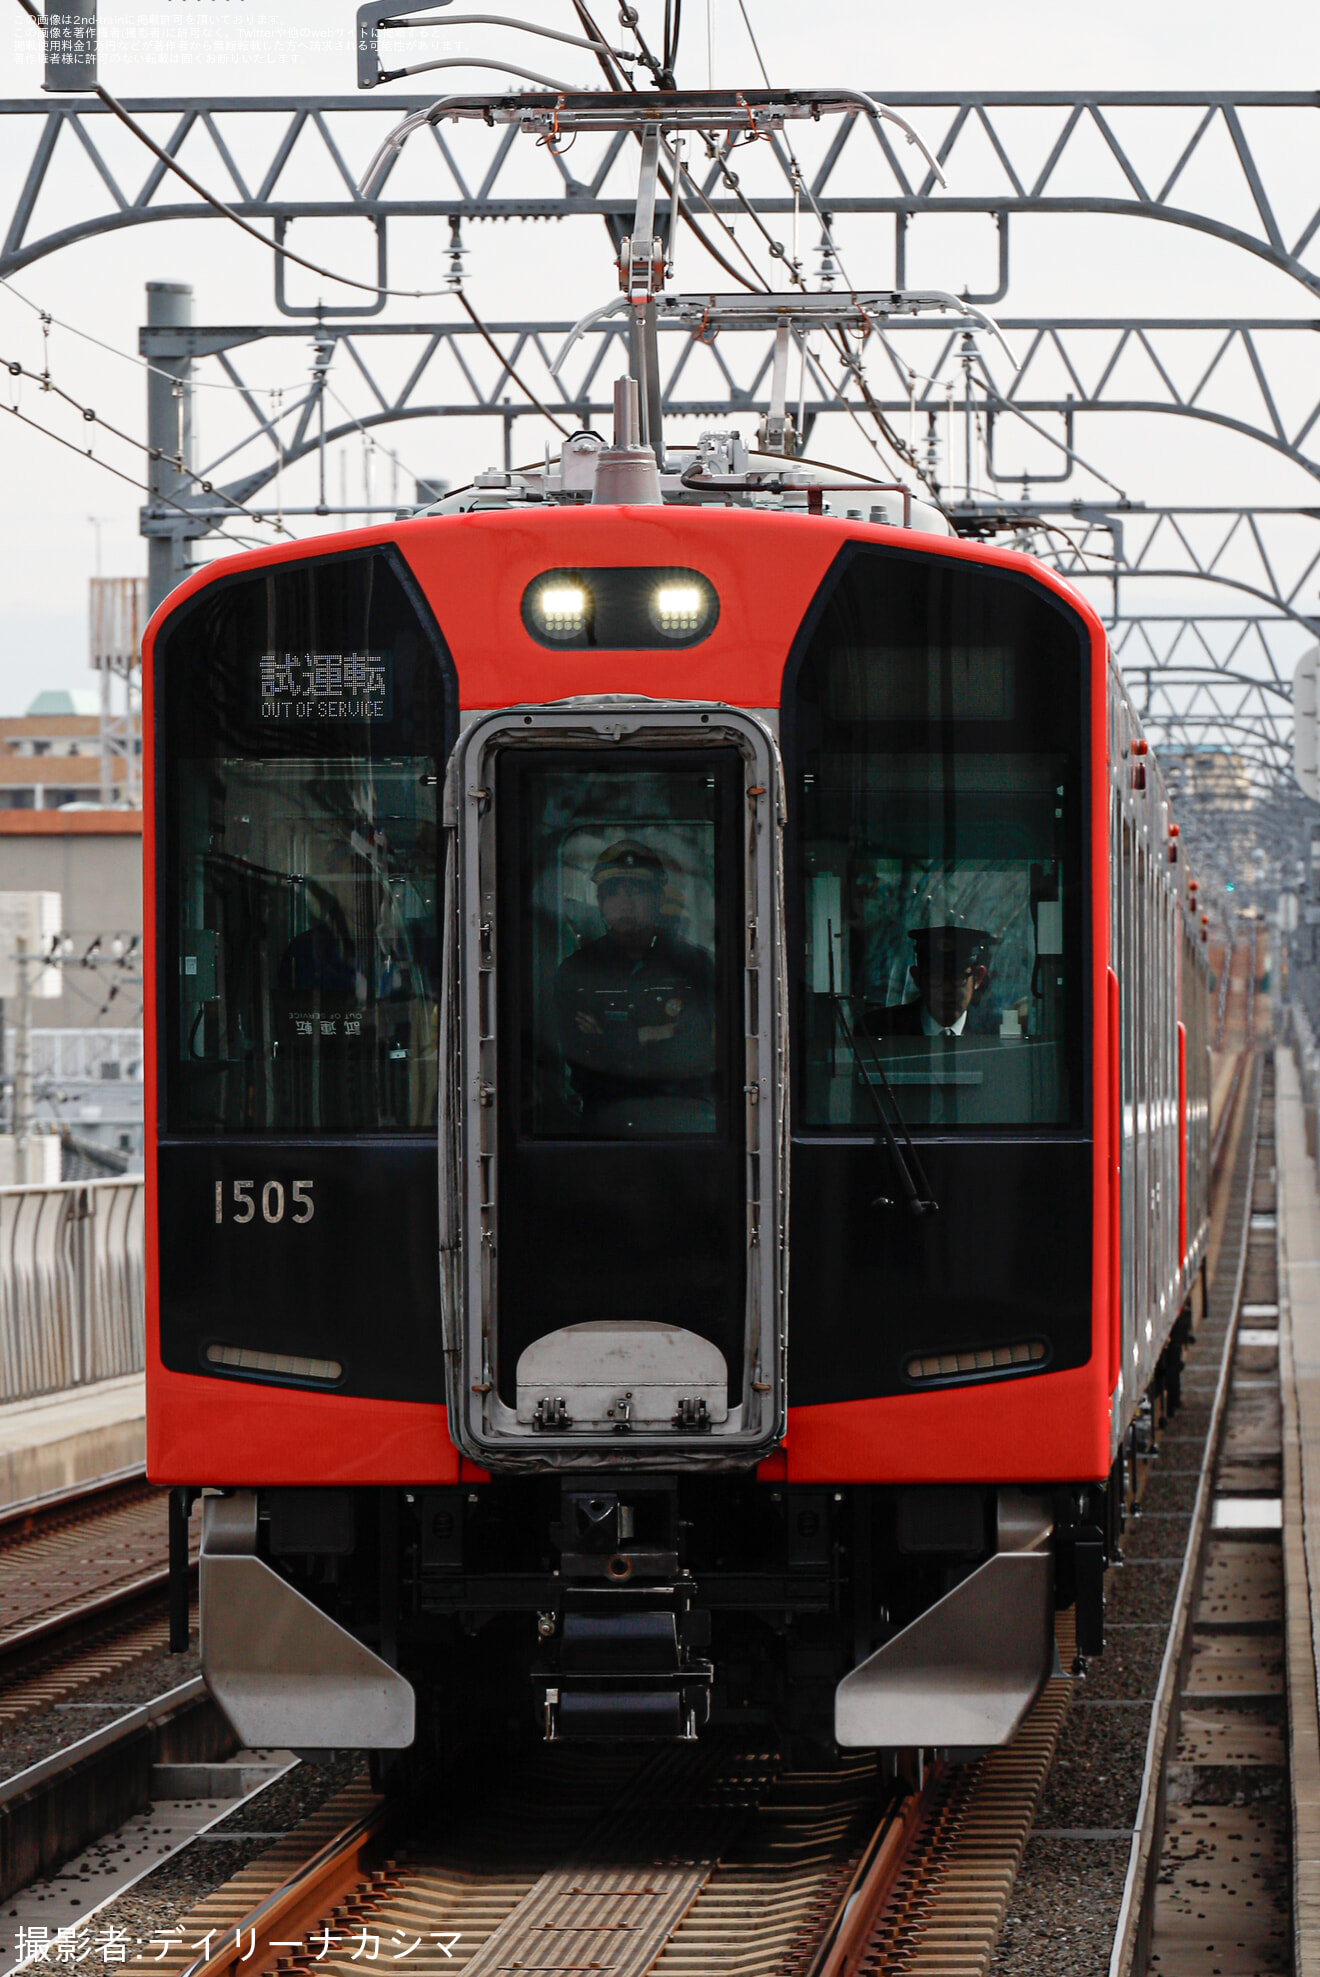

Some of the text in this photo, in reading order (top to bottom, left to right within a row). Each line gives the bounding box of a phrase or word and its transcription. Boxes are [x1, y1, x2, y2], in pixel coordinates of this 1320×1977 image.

[260, 653, 385, 696] 試運転
[261, 701, 383, 717] OUT OF SERVICE
[215, 1180, 315, 1224] 1505
